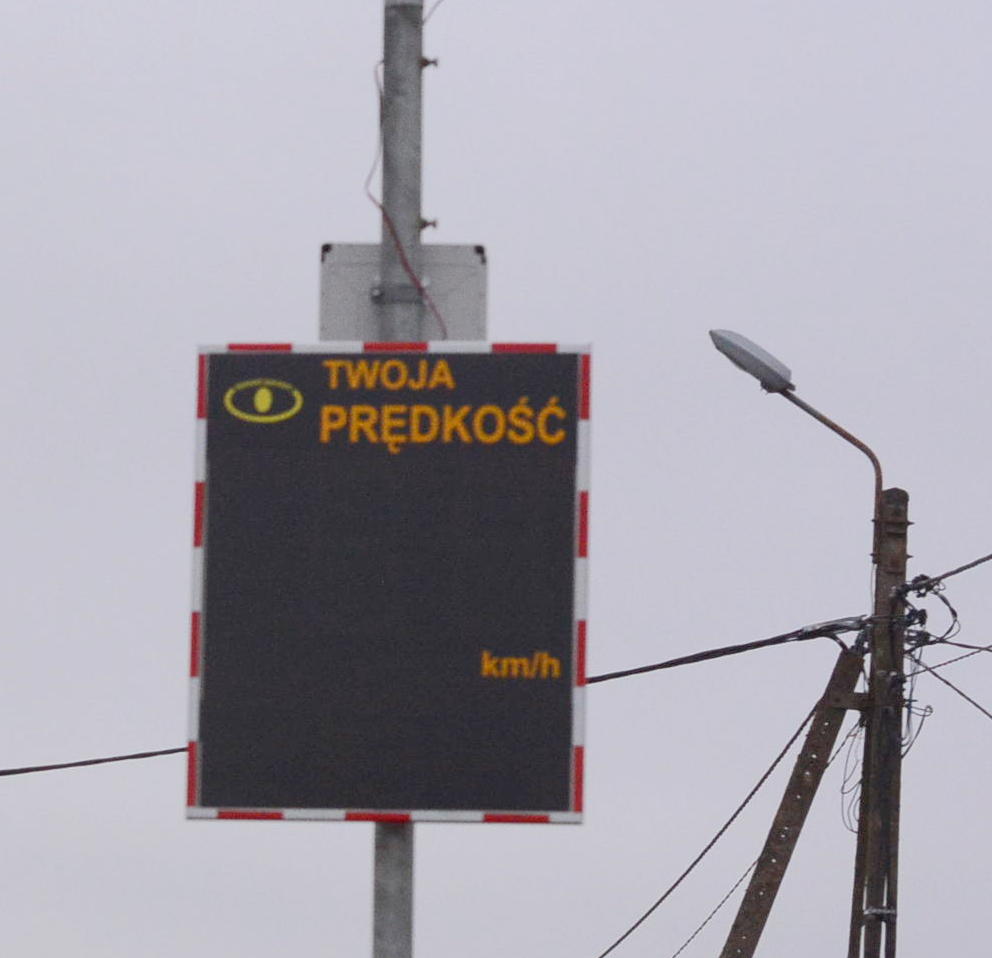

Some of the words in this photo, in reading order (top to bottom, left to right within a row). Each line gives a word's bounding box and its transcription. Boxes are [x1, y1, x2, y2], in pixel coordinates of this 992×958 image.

[323, 358, 457, 391] TWOJA
[319, 396, 568, 455] PRĘDKOŚĆ
[480, 651, 562, 679] km/h
